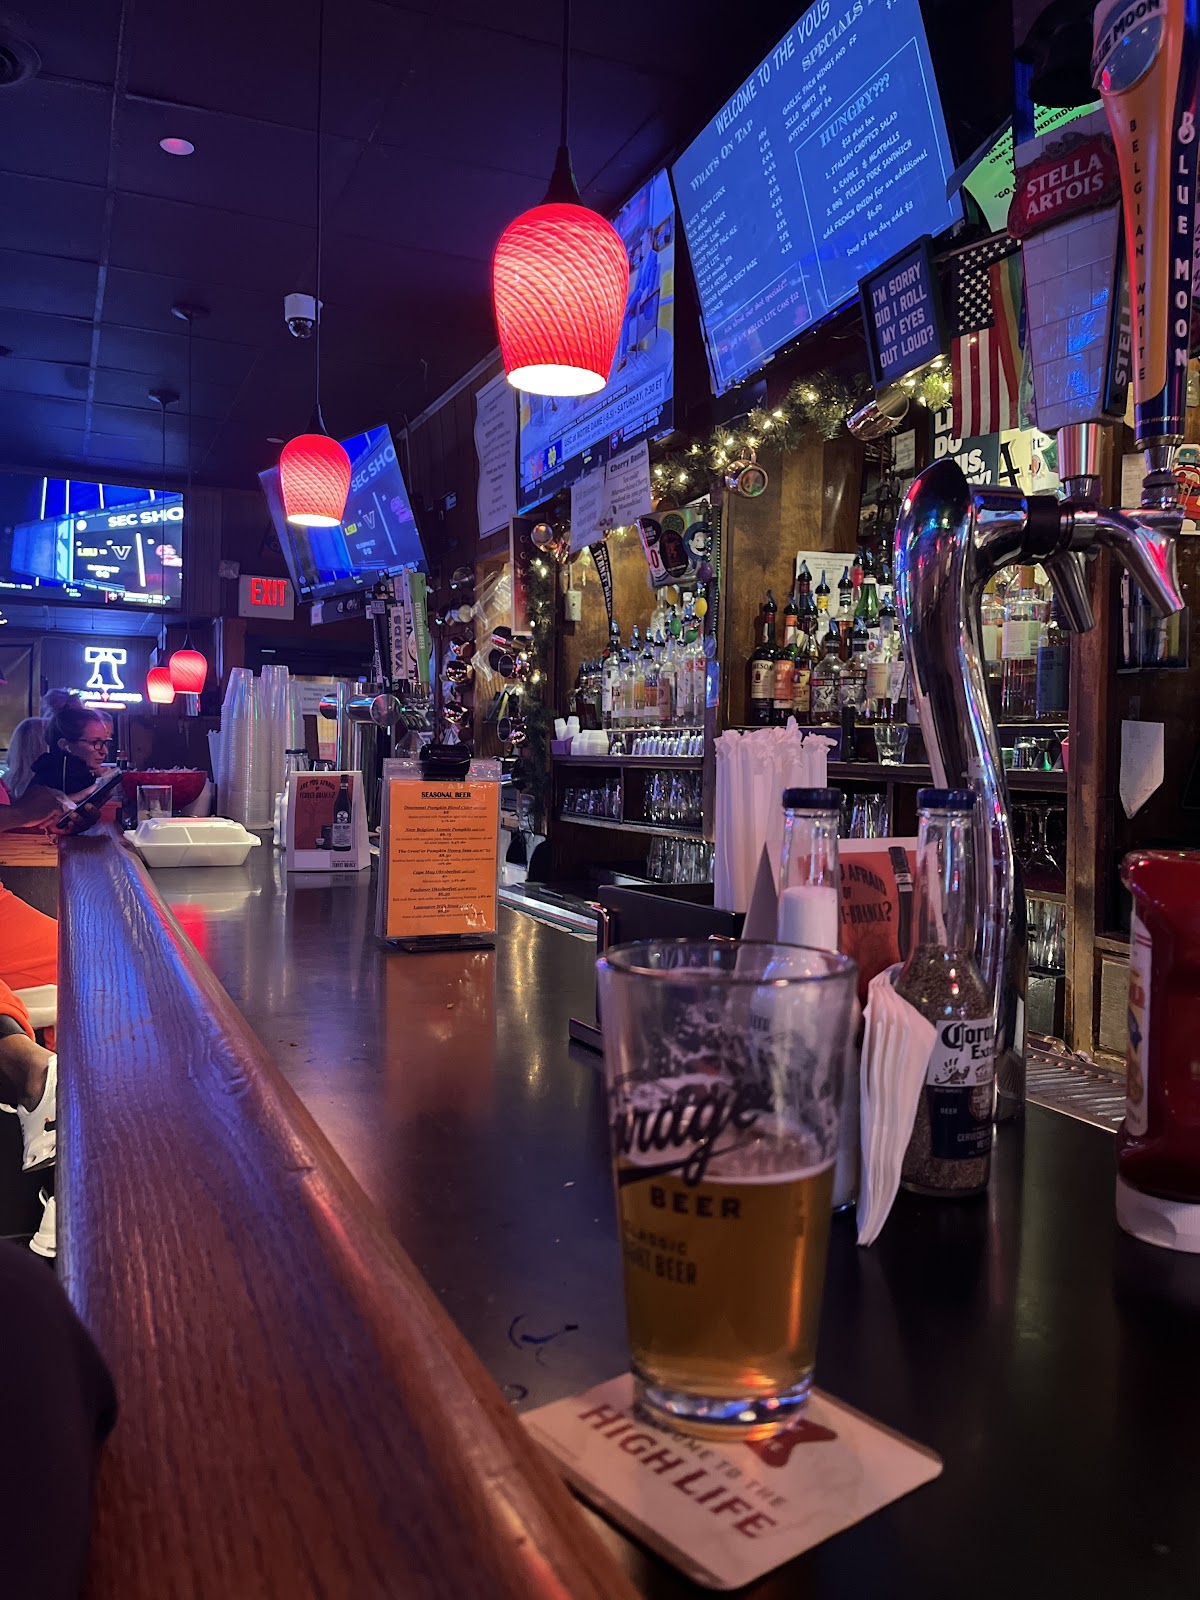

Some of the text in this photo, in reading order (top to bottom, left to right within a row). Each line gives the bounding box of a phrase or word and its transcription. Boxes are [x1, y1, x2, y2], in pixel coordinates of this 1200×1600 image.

[801, 0, 863, 70] SPECIALS
[715, 0, 829, 135] WELCOME TO THE VOUS
[782, 92, 801, 116] GARLIC
[816, 57, 834, 80] WINGS
[834, 45, 845, 61] AND
[785, 110, 799, 129] JELLO
[801, 92, 816, 112] SHOTS
[788, 117, 810, 142] MYSTERY
[810, 103, 823, 120] SHOT
[820, 74, 890, 144] HUNGRY???
[852, 122, 864, 139] plus
[865, 112, 874, 126] tax
[831, 149, 854, 174] ITALIAN
[853, 127, 879, 153] CHOPPED
[880, 110, 897, 130] SALAD
[868, 131, 900, 162] MEATBALLS
[845, 178, 865, 200] PULLED
[866, 164, 881, 182] PORK
[882, 138, 912, 168] SANDWICH
[1027, 154, 1103, 198] STELLA
[1129, 119, 1145, 257] BELGIAN
[823, 148, 927, 239] add FRENCH ONION for an additional
[1026, 173, 1104, 220] ARTOIS
[846, 241, 859, 257] Soup
[860, 234, 867, 247] of
[868, 227, 877, 240] the
[878, 217, 890, 233] day
[891, 207, 903, 222] add
[1174, 111, 1194, 367] BLUE MOON
[873, 262, 922, 308] I'M SORRY
[874, 310, 891, 329] DID
[900, 286, 927, 313] ROLL
[880, 325, 935, 370] OUT LOUD?
[881, 308, 925, 347] MY EYES
[1136, 281, 1146, 381] WHITE
[351, 444, 397, 493] SEC SHO
[610, 460, 629, 473] Cherry
[108, 506, 184, 528] SEC SHO
[250, 577, 287, 607] EXIT
[394, 615, 403, 675] YARDS
[940, 1107, 958, 1115] BEER
[650, 1185, 741, 1218] BEER
[655, 1254, 698, 1285] BEER
[577, 1403, 685, 1475] HIGH
[671, 1469, 777, 1538] LIFE
